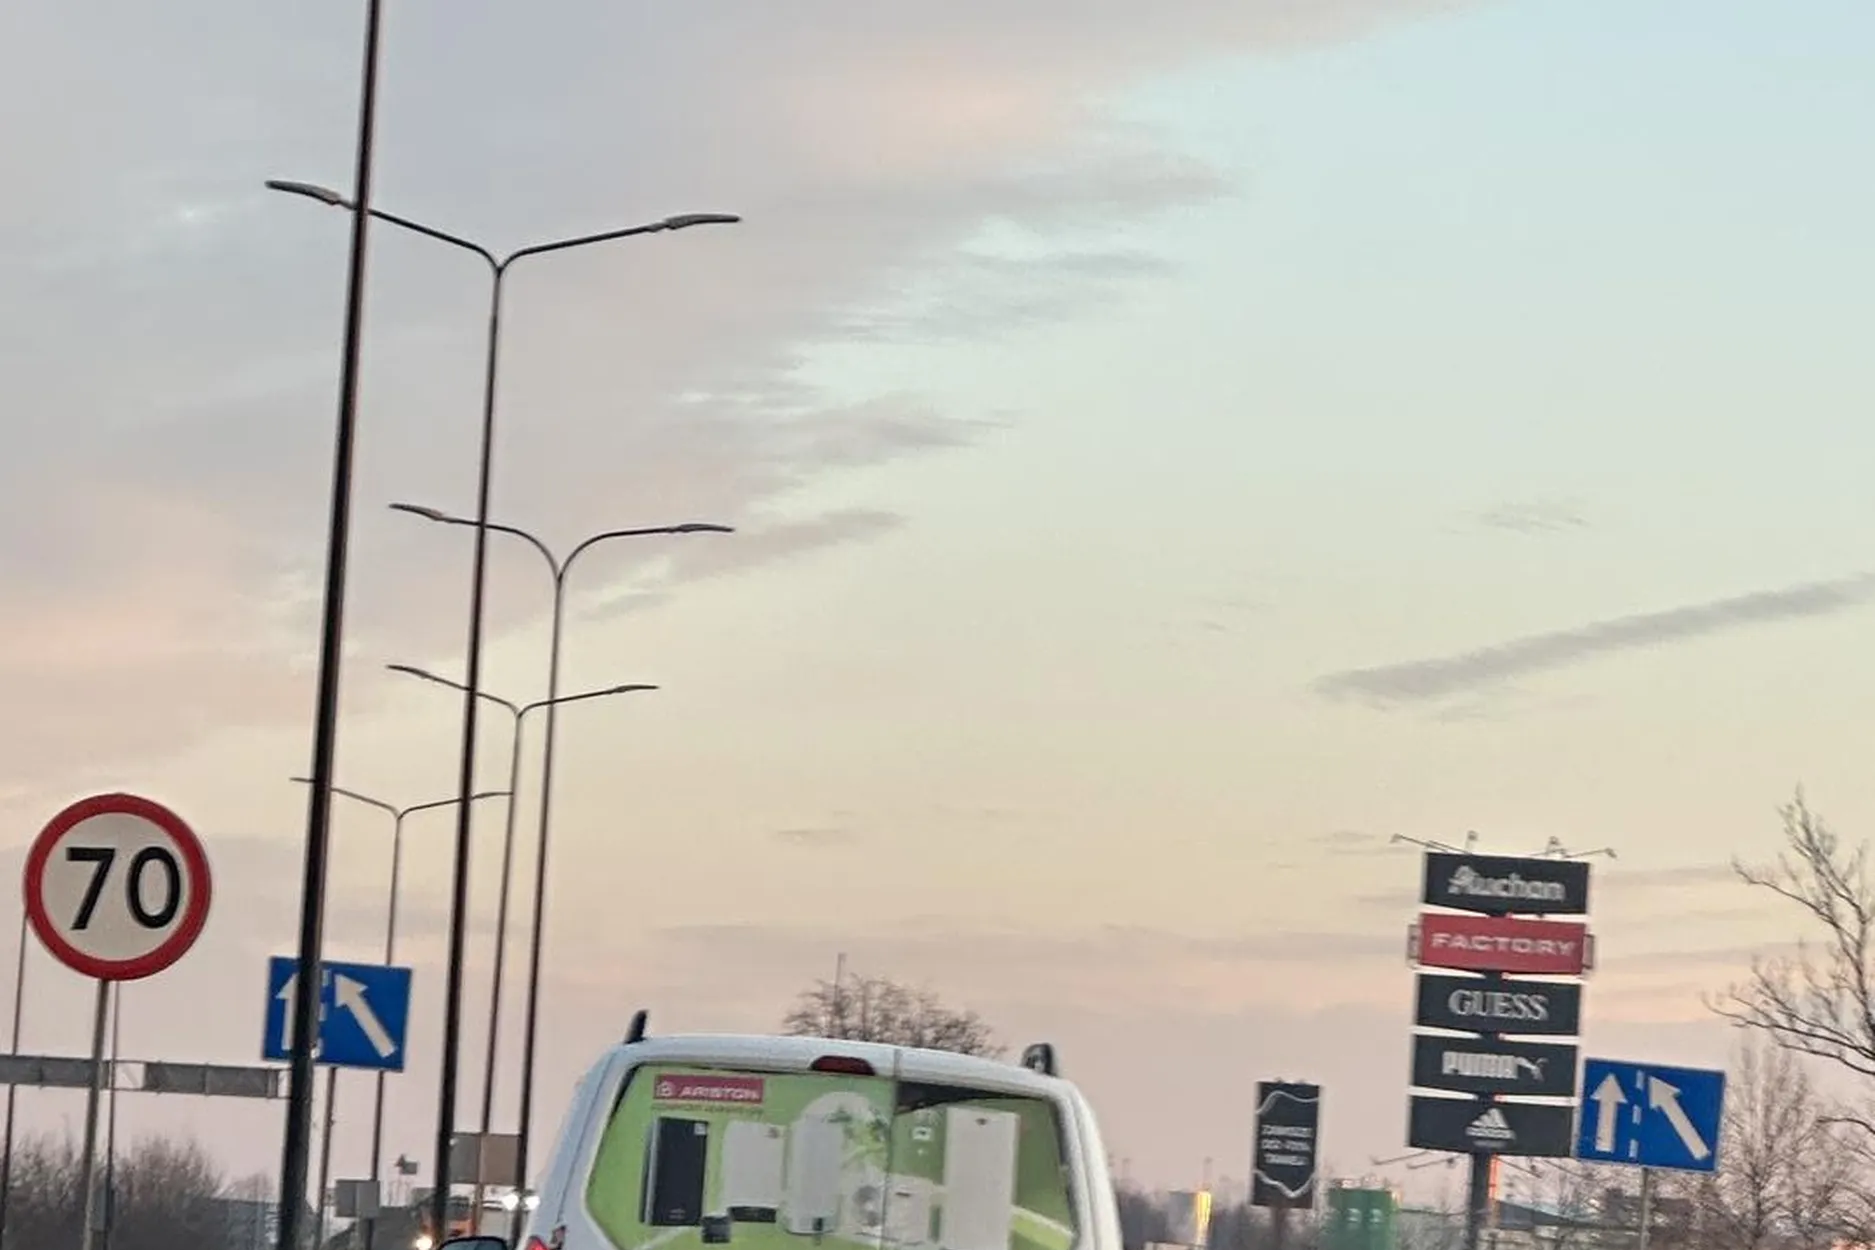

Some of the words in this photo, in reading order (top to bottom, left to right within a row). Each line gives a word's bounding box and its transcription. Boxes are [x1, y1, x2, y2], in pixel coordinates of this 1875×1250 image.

[66, 846, 181, 930] 70
[1448, 865, 1566, 901] Auchan
[1430, 932, 1577, 956] FACTORY
[1448, 989, 1549, 1020] GUESS
